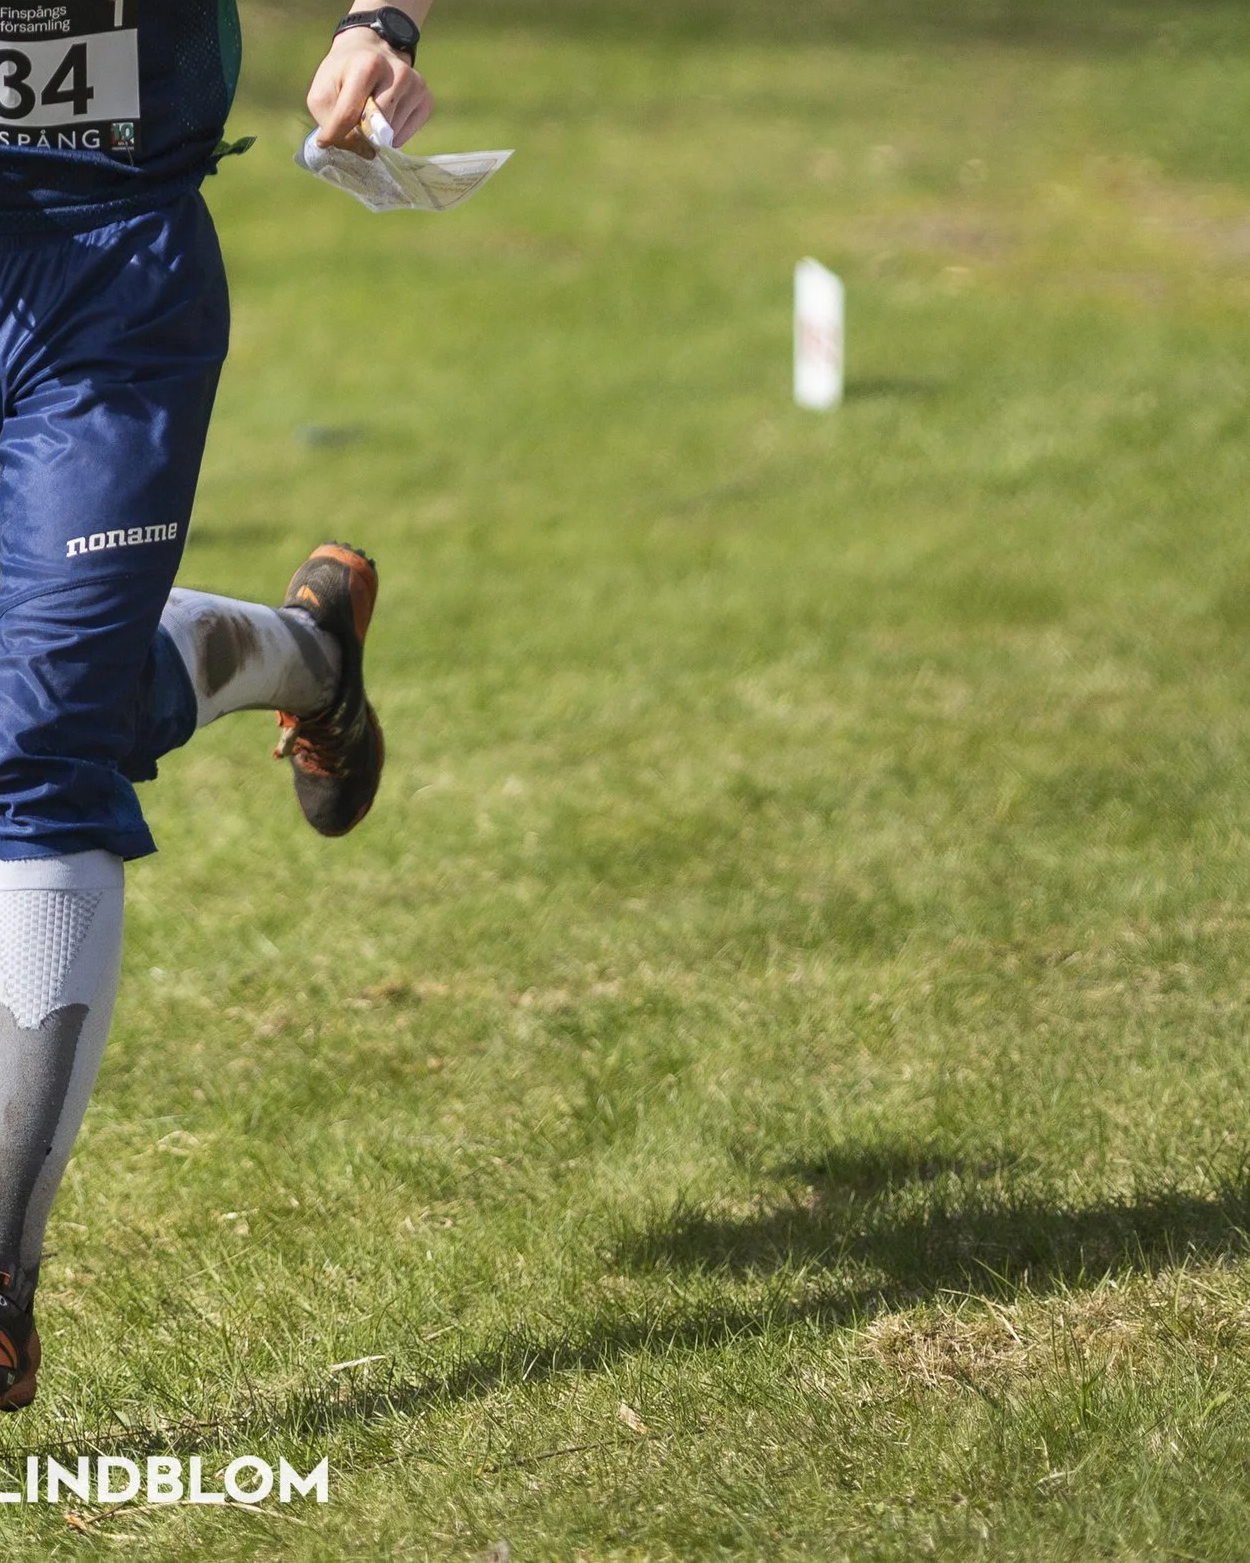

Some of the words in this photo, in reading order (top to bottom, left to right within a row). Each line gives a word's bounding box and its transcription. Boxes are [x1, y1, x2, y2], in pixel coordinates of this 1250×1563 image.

[0, 5, 67, 20] Finspångs
[0, 17, 71, 33] församling
[66, 522, 178, 558] noname
